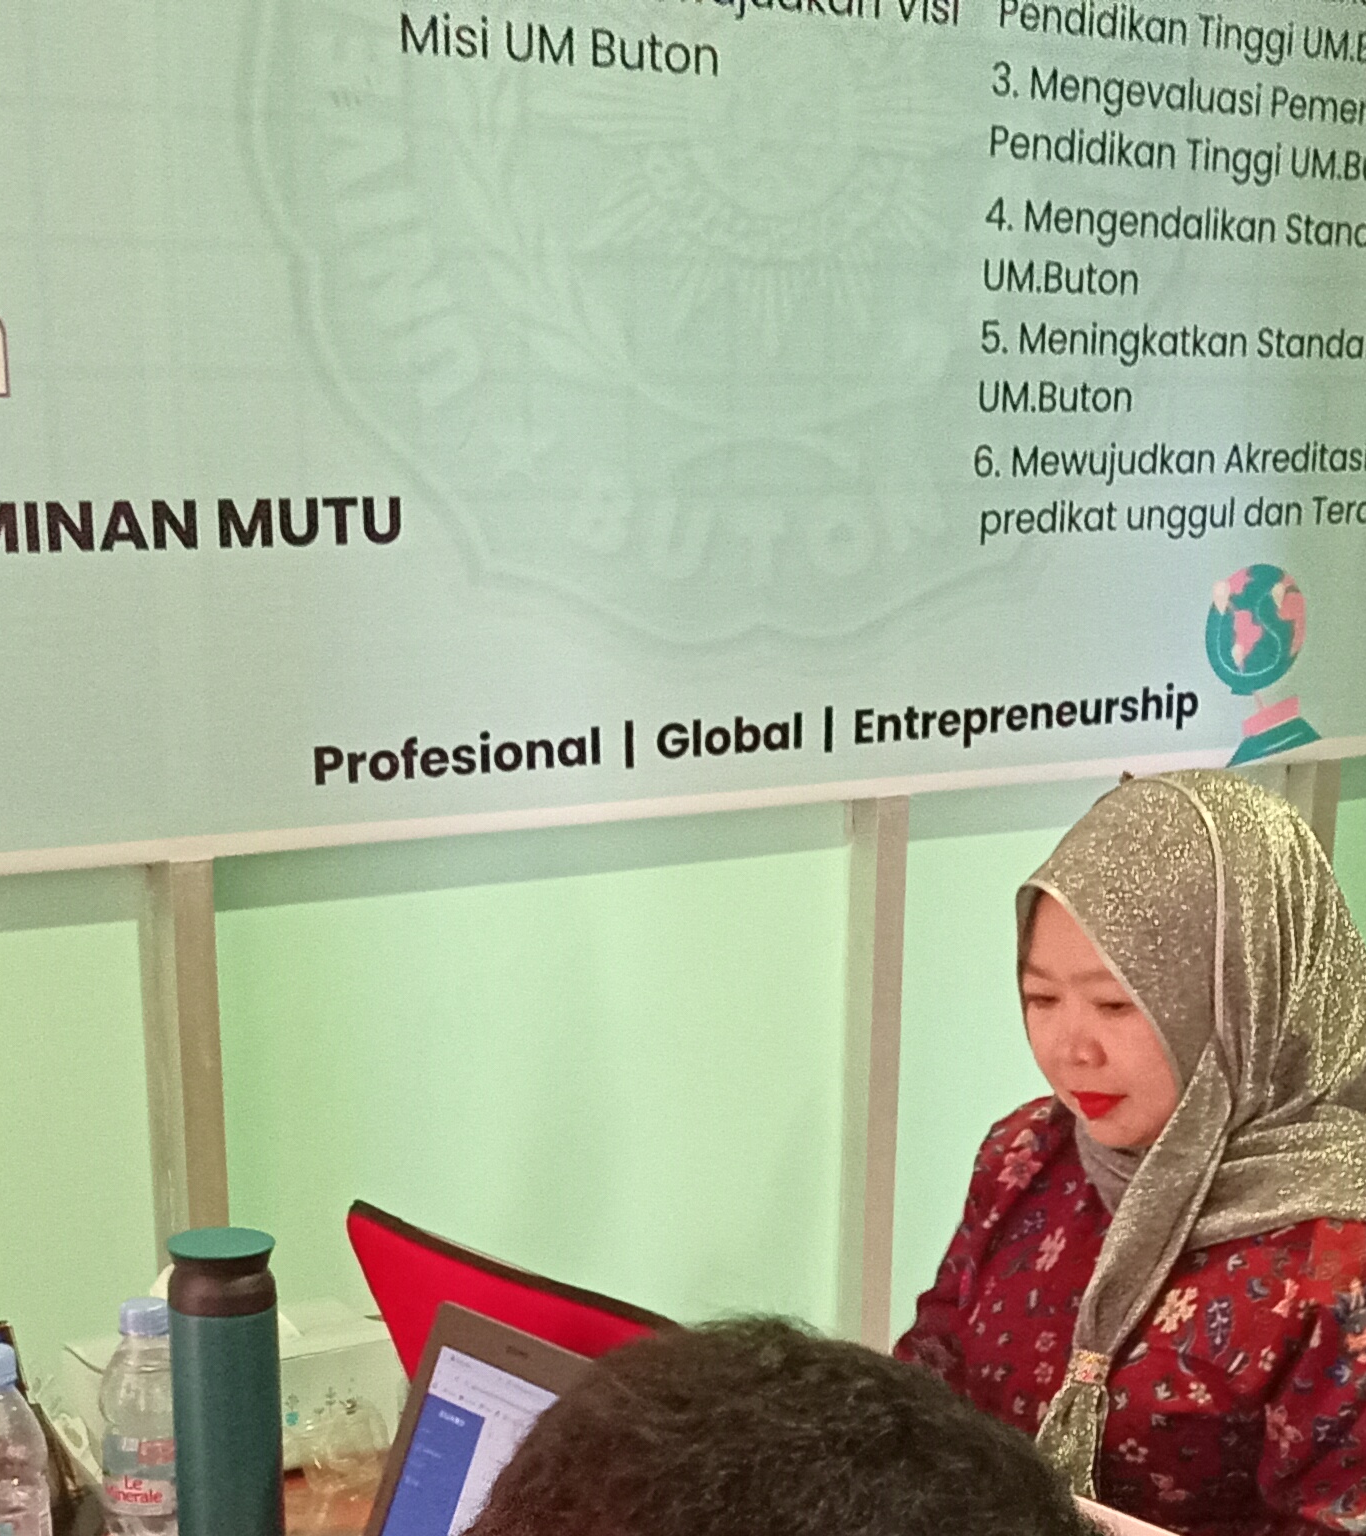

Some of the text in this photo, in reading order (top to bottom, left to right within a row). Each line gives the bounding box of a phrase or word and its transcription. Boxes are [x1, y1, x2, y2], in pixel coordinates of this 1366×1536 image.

[399, 10, 719, 78] Misi UM Buton
[998, 0, 1188, 47] Pendidikan
[1196, 11, 1295, 68] Tinggi
[991, 59, 1020, 99] 3.
[1029, 64, 1263, 119] Mengevaluasi
[989, 123, 1177, 171] Pendidikan
[1185, 136, 1283, 188] Tinggi
[984, 196, 1014, 232] 4.
[1023, 198, 1277, 249] Mengendalikan
[983, 257, 1139, 297] UM.Buton
[980, 318, 1009, 355] 5.
[1018, 320, 1248, 368] Meningkatkan
[978, 379, 1133, 414] UM.Buton
[973, 443, 1001, 479] 6.
[1011, 440, 1216, 487] Mewujudkan
[216, 495, 402, 550] MUTU
[979, 498, 1118, 547] predikat
[1126, 495, 1236, 541] unggul
[1243, 495, 1303, 528] dan
[313, 725, 602, 787] Profesional
[655, 710, 804, 761] Global
[853, 681, 1200, 750] Entrepreneurship
[123, 1474, 143, 1490] Le
